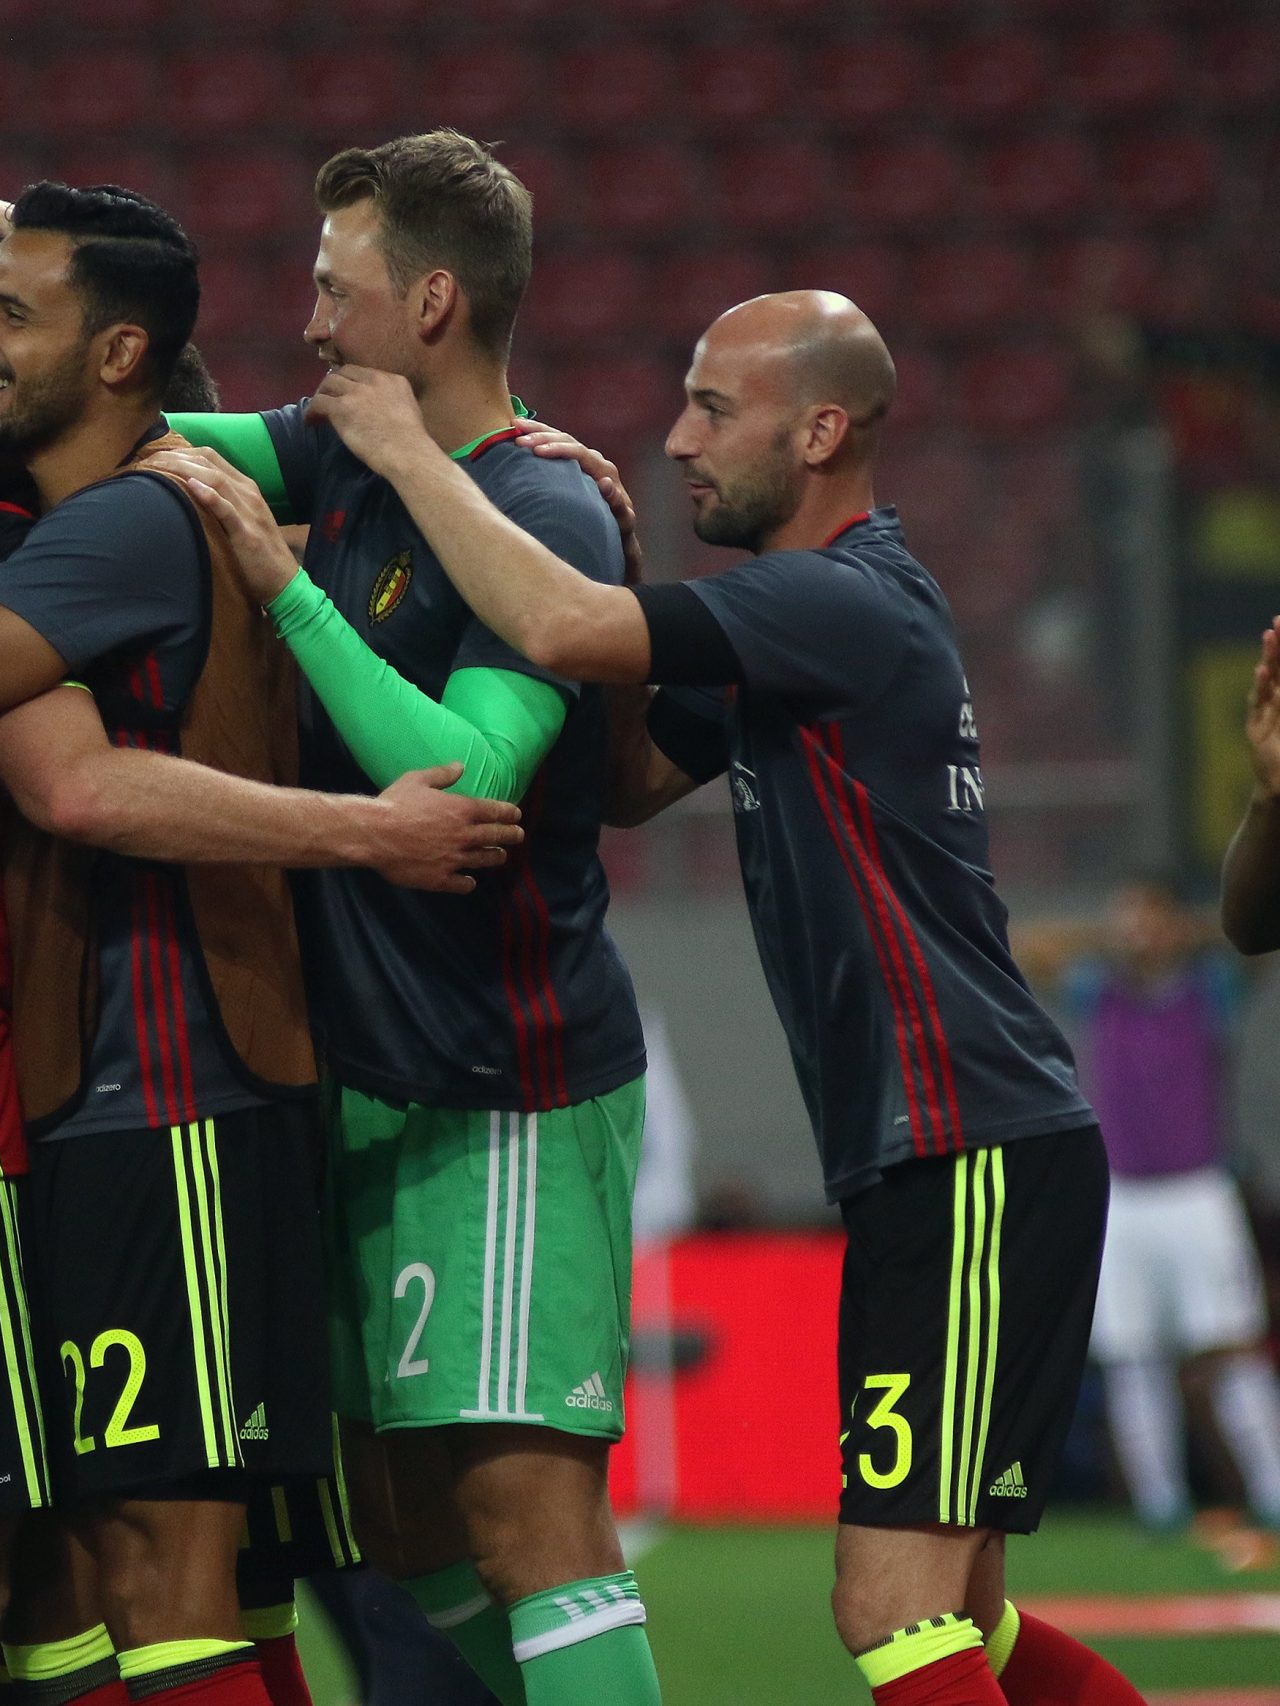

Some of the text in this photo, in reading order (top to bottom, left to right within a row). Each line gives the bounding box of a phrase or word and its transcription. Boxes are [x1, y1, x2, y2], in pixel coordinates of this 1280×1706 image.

[565, 1394, 613, 1412] adidas
[239, 1426, 269, 1440] adidas
[840, 1373, 913, 1490] 3
[989, 1483, 1028, 1498] adidas
